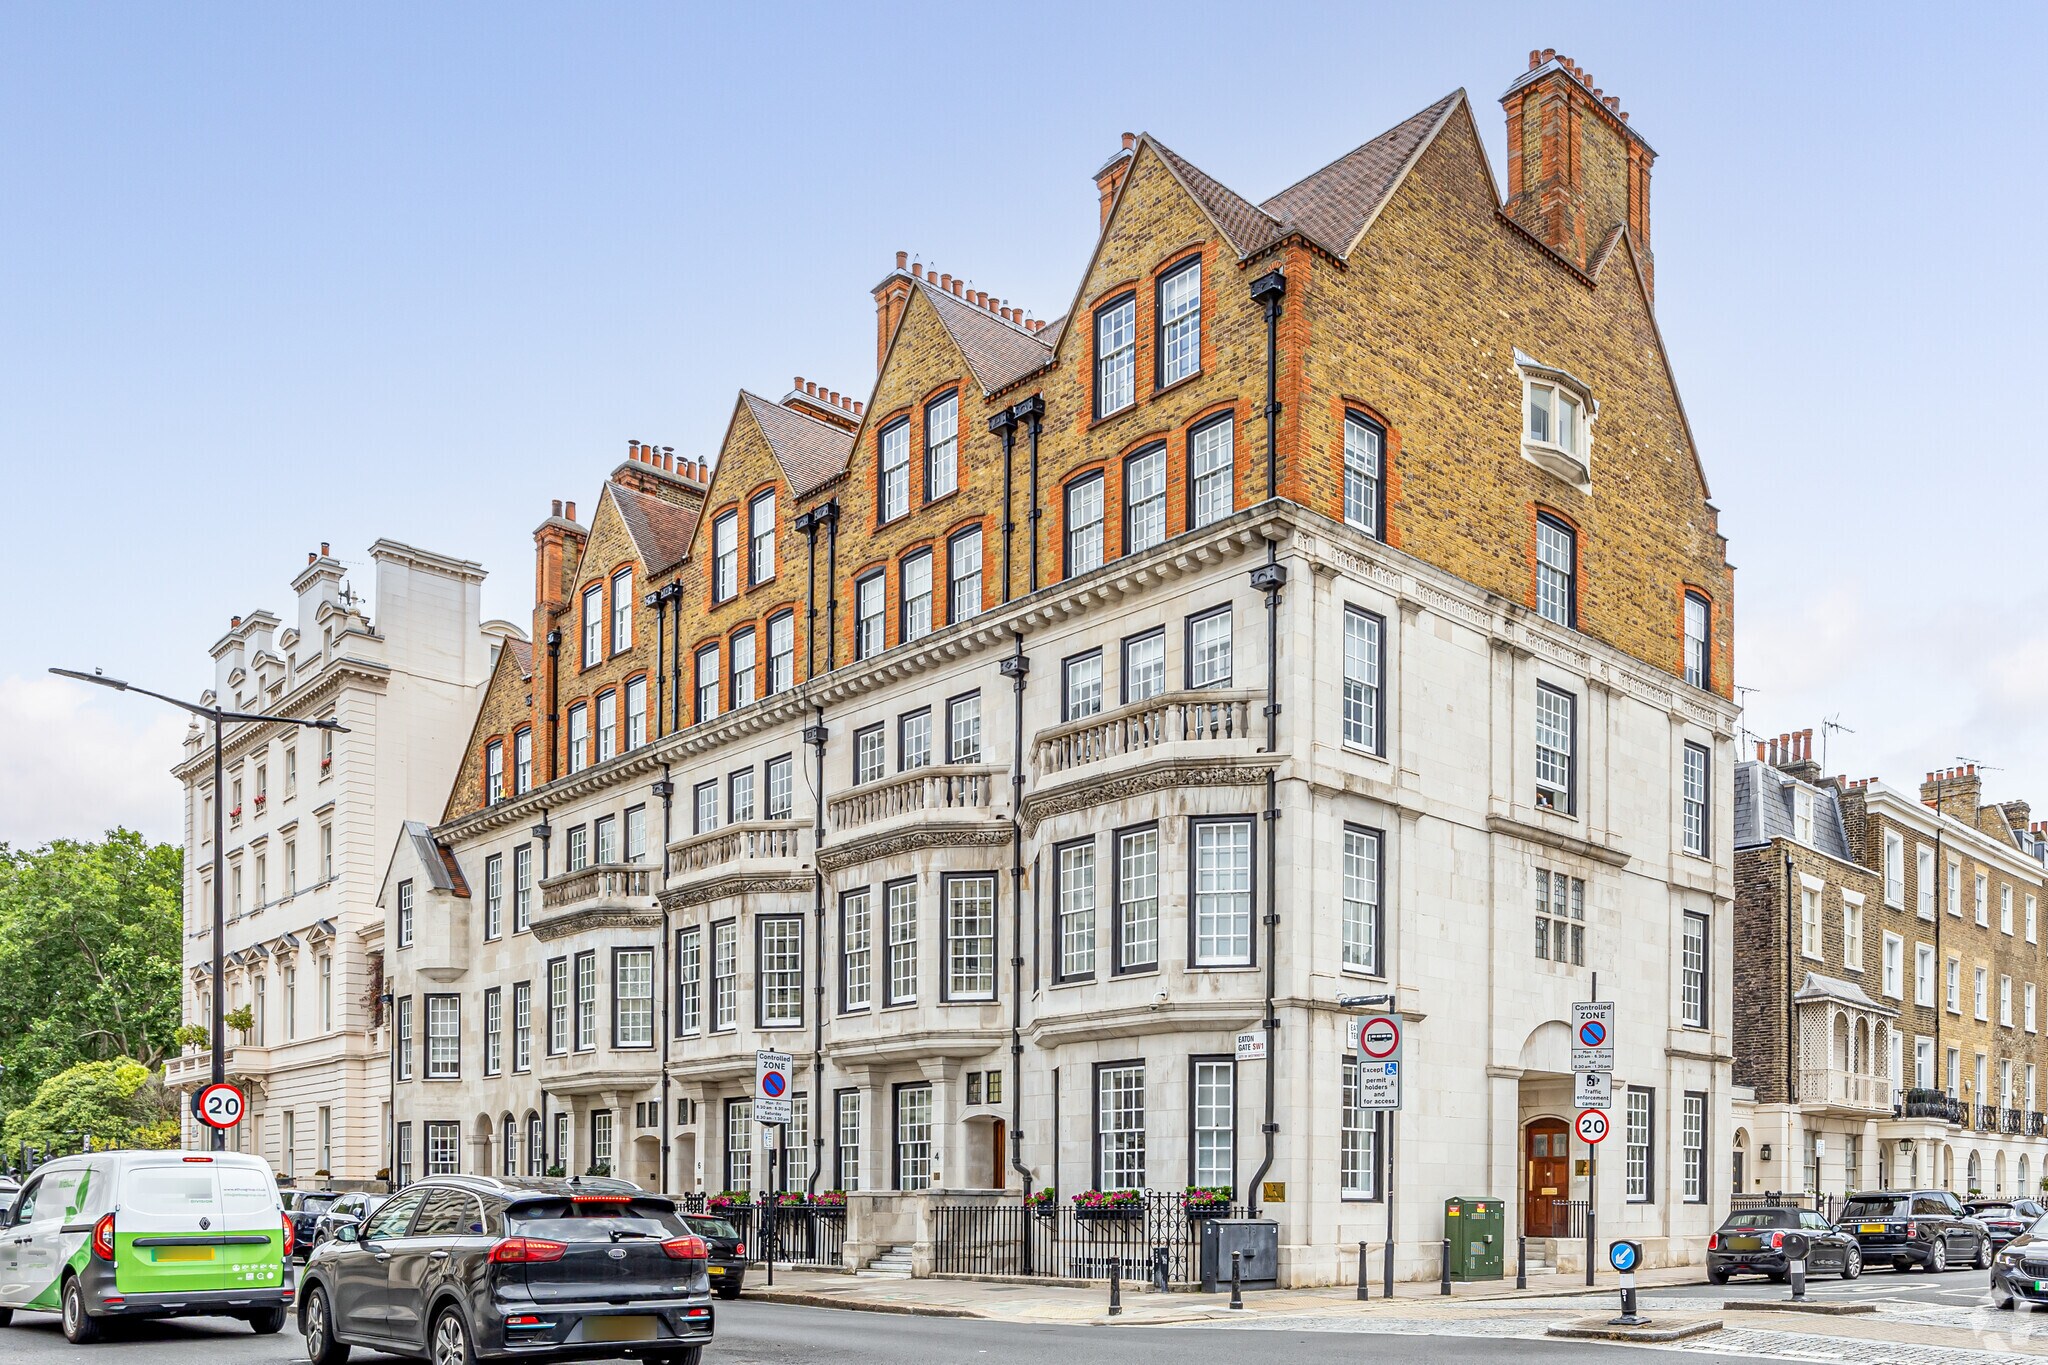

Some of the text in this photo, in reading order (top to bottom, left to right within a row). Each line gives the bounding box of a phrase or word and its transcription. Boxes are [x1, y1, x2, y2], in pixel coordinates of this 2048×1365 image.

[759, 1053, 790, 1062] Controlled
[764, 1062, 785, 1070] ZONE
[209, 1097, 239, 1115] 20
[1582, 1120, 1604, 1133] 20
[935, 1152, 939, 1160] 4
